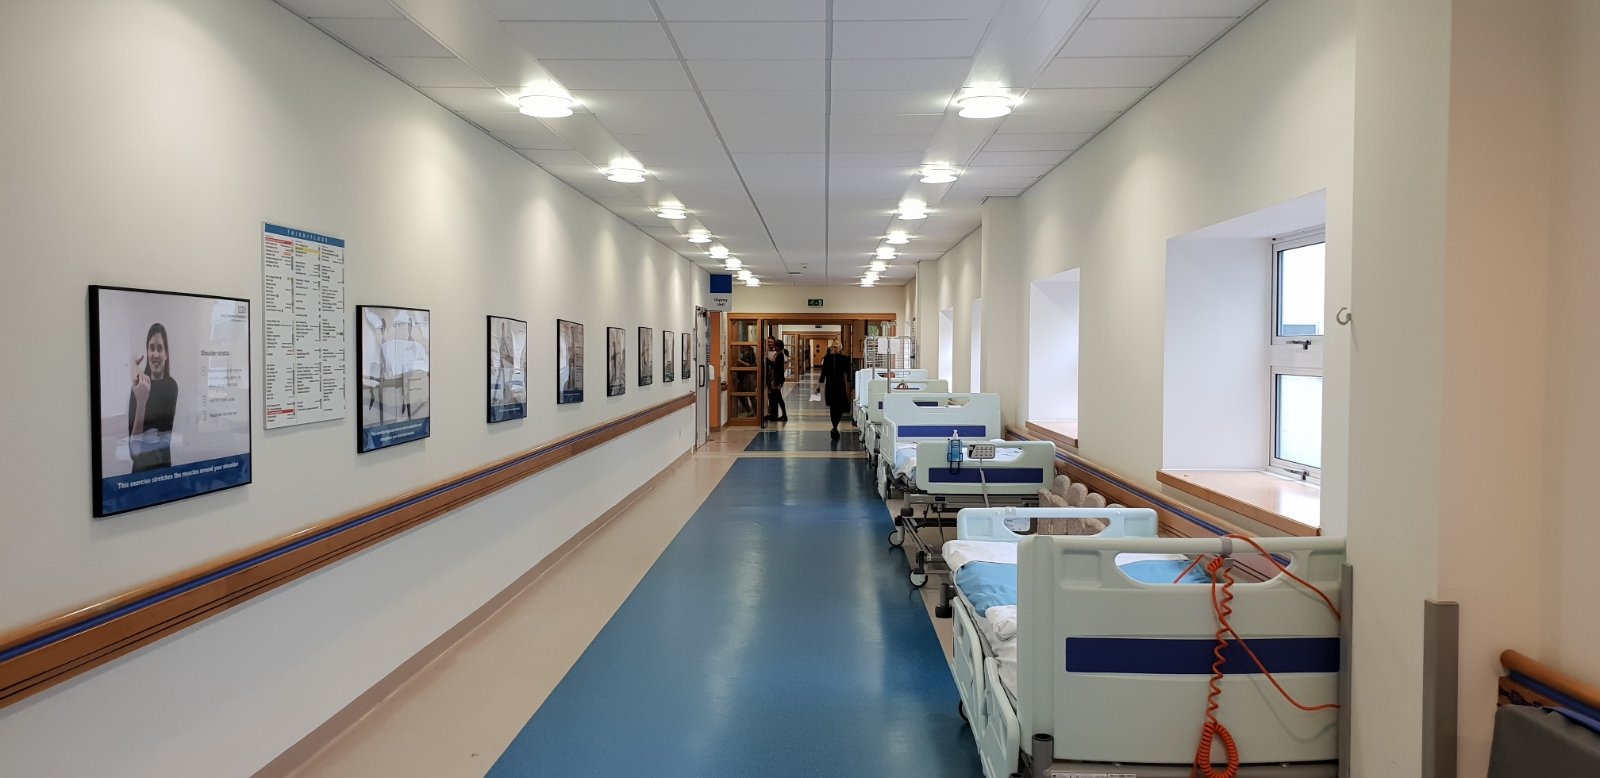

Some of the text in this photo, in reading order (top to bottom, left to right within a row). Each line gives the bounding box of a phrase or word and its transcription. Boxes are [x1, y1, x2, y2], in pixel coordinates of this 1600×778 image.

[130, 479, 151, 487] exercise
[152, 475, 173, 483] stretches
[182, 469, 199, 477] muscles
[199, 466, 213, 474] around
